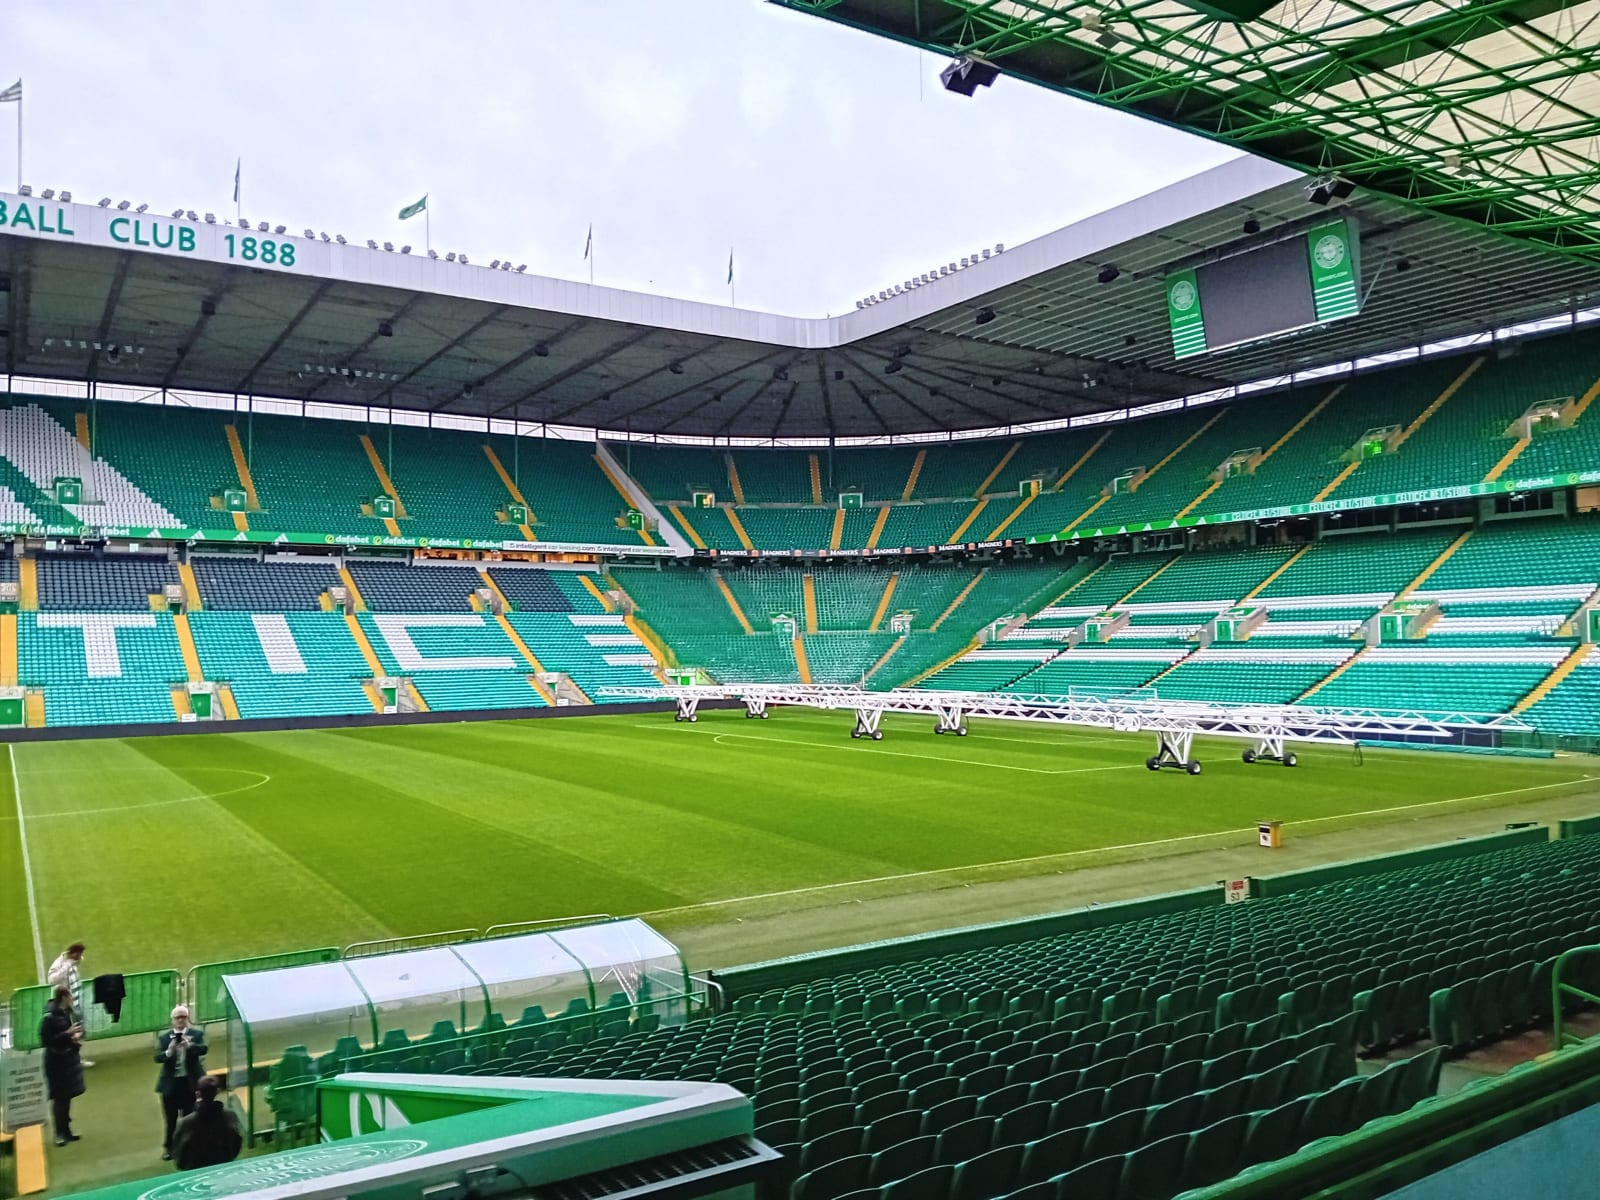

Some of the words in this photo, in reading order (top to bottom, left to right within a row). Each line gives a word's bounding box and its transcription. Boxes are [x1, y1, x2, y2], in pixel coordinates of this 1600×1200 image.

[109, 217, 197, 252] CLUB
[224, 233, 296, 267] 1888
[1516, 477, 1554, 488] dafabet
[336, 535, 369, 545] dafabet
[384, 536, 415, 546] dafabet
[429, 537, 460, 547] dafabet
[473, 538, 502, 549] dafabet
[830, 549, 859, 557] MAGNERS
[873, 547, 901, 555] MAGNERS
[938, 543, 966, 551] MAGNERS
[978, 540, 1003, 549] MAGNERS
